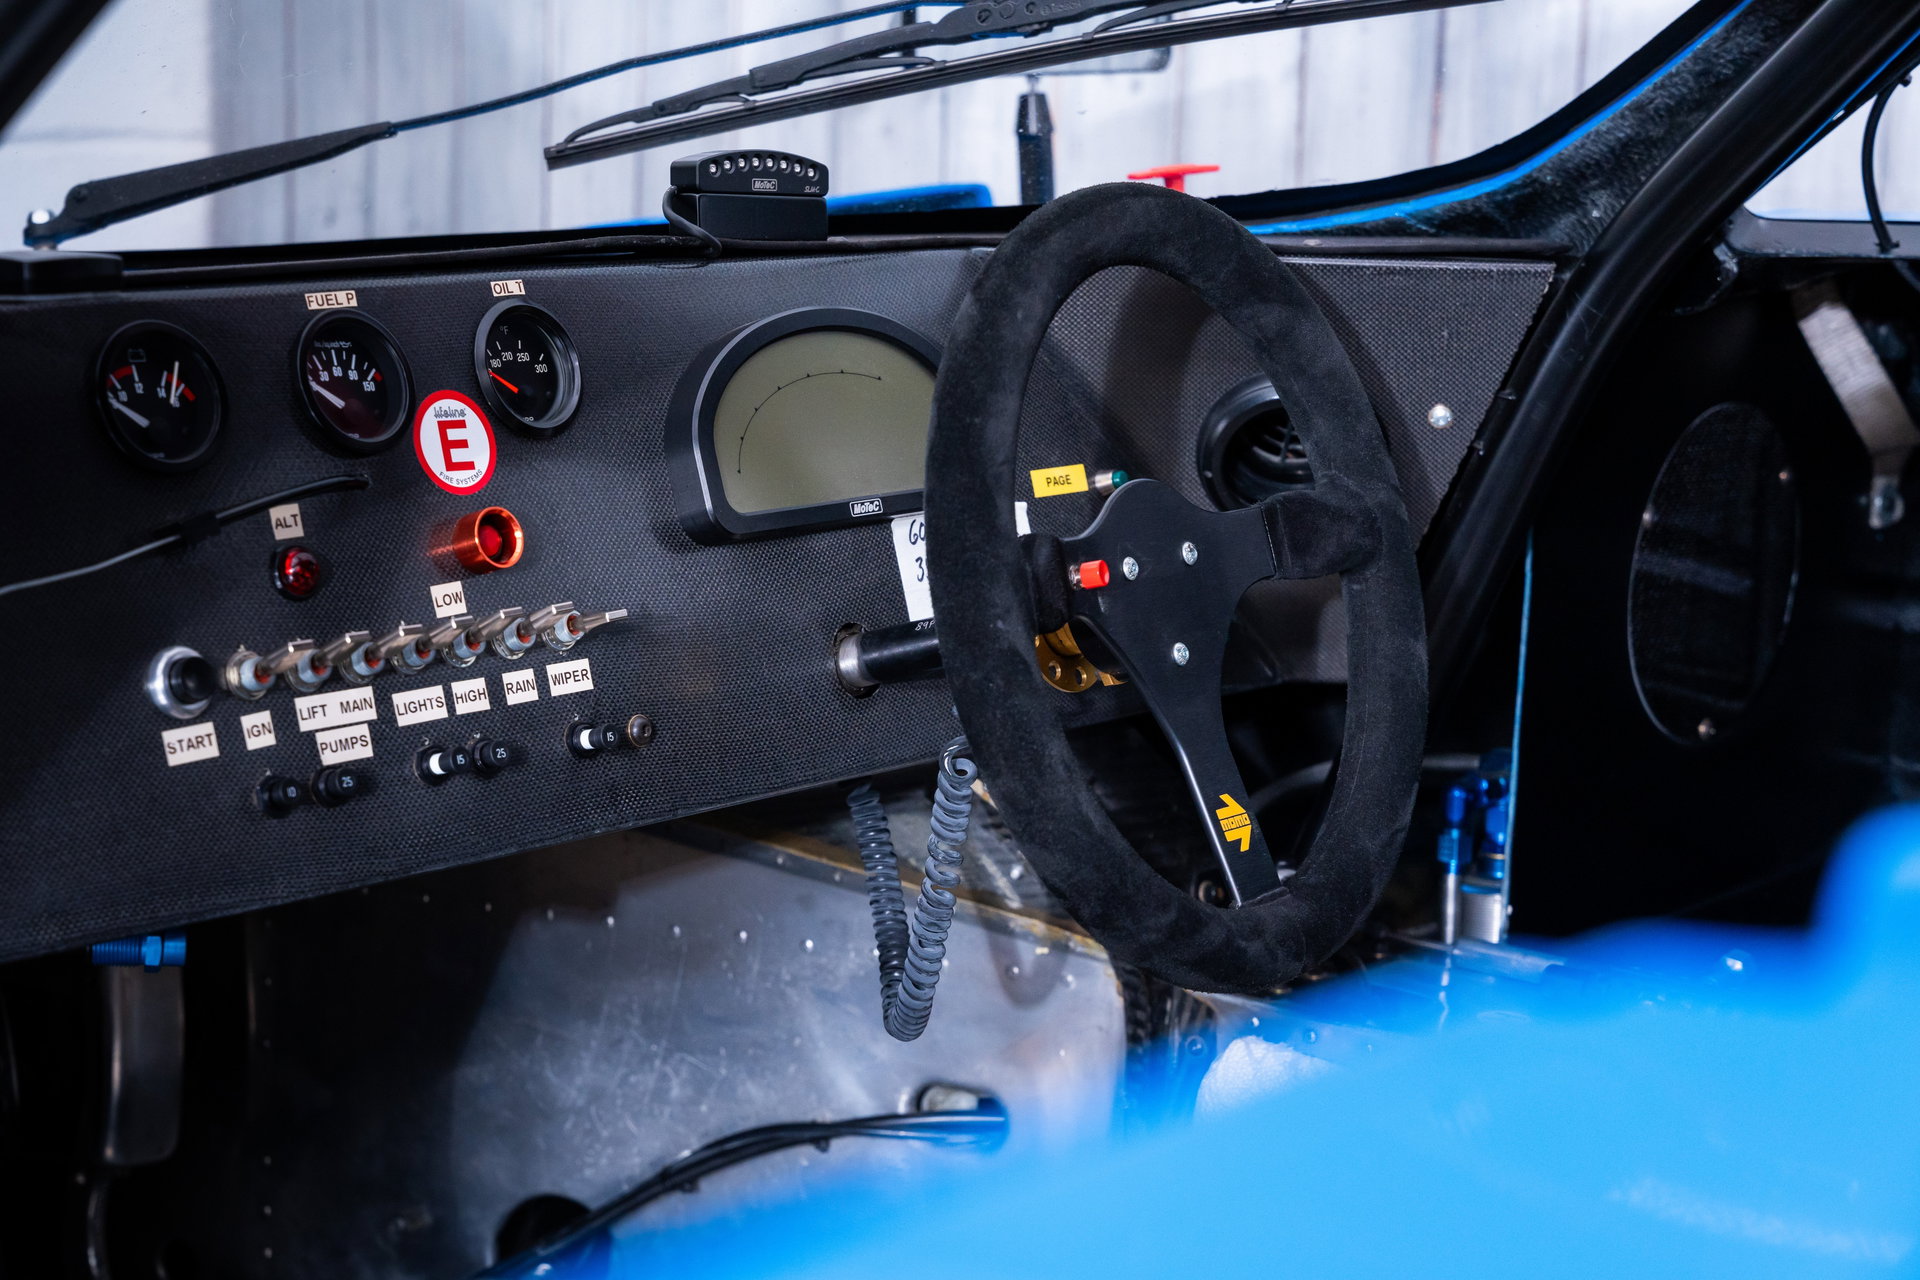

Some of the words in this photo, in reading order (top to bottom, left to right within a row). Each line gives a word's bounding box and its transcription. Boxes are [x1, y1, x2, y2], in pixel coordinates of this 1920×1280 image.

[754, 180, 775, 189] MoTeC
[493, 282, 513, 295] OIL
[515, 281, 524, 293] T
[307, 294, 343, 307] FUEL
[346, 293, 354, 304] P
[501, 351, 513, 361] 210
[517, 352, 530, 362] 250
[490, 358, 502, 368] 180
[535, 363, 548, 373] 300
[319, 371, 329, 382] 30
[332, 366, 343, 377] 60
[348, 370, 358, 381] 90
[363, 381, 375, 392] 150
[437, 420, 475, 471] E
[439, 471, 454, 484] FIRE
[456, 470, 483, 486] SYSTEMS
[1046, 474, 1072, 487] PAGE
[853, 502, 880, 514] MoTeC
[275, 514, 299, 530] ALT
[915, 556, 927, 582] 3
[434, 592, 463, 609] LOW
[551, 669, 589, 686] WIPER
[505, 678, 536, 695] RAIN
[455, 687, 487, 705] HIGH
[299, 704, 327, 720] LIFT
[341, 697, 373, 714] MAIN
[397, 697, 444, 715] LIGHTS
[247, 722, 272, 739] IGN
[606, 731, 615, 742] 15
[167, 734, 213, 755] START
[320, 735, 369, 755] PUMPS
[456, 753, 465, 765] 15
[495, 748, 506, 759] 25
[341, 775, 354, 788] 25
